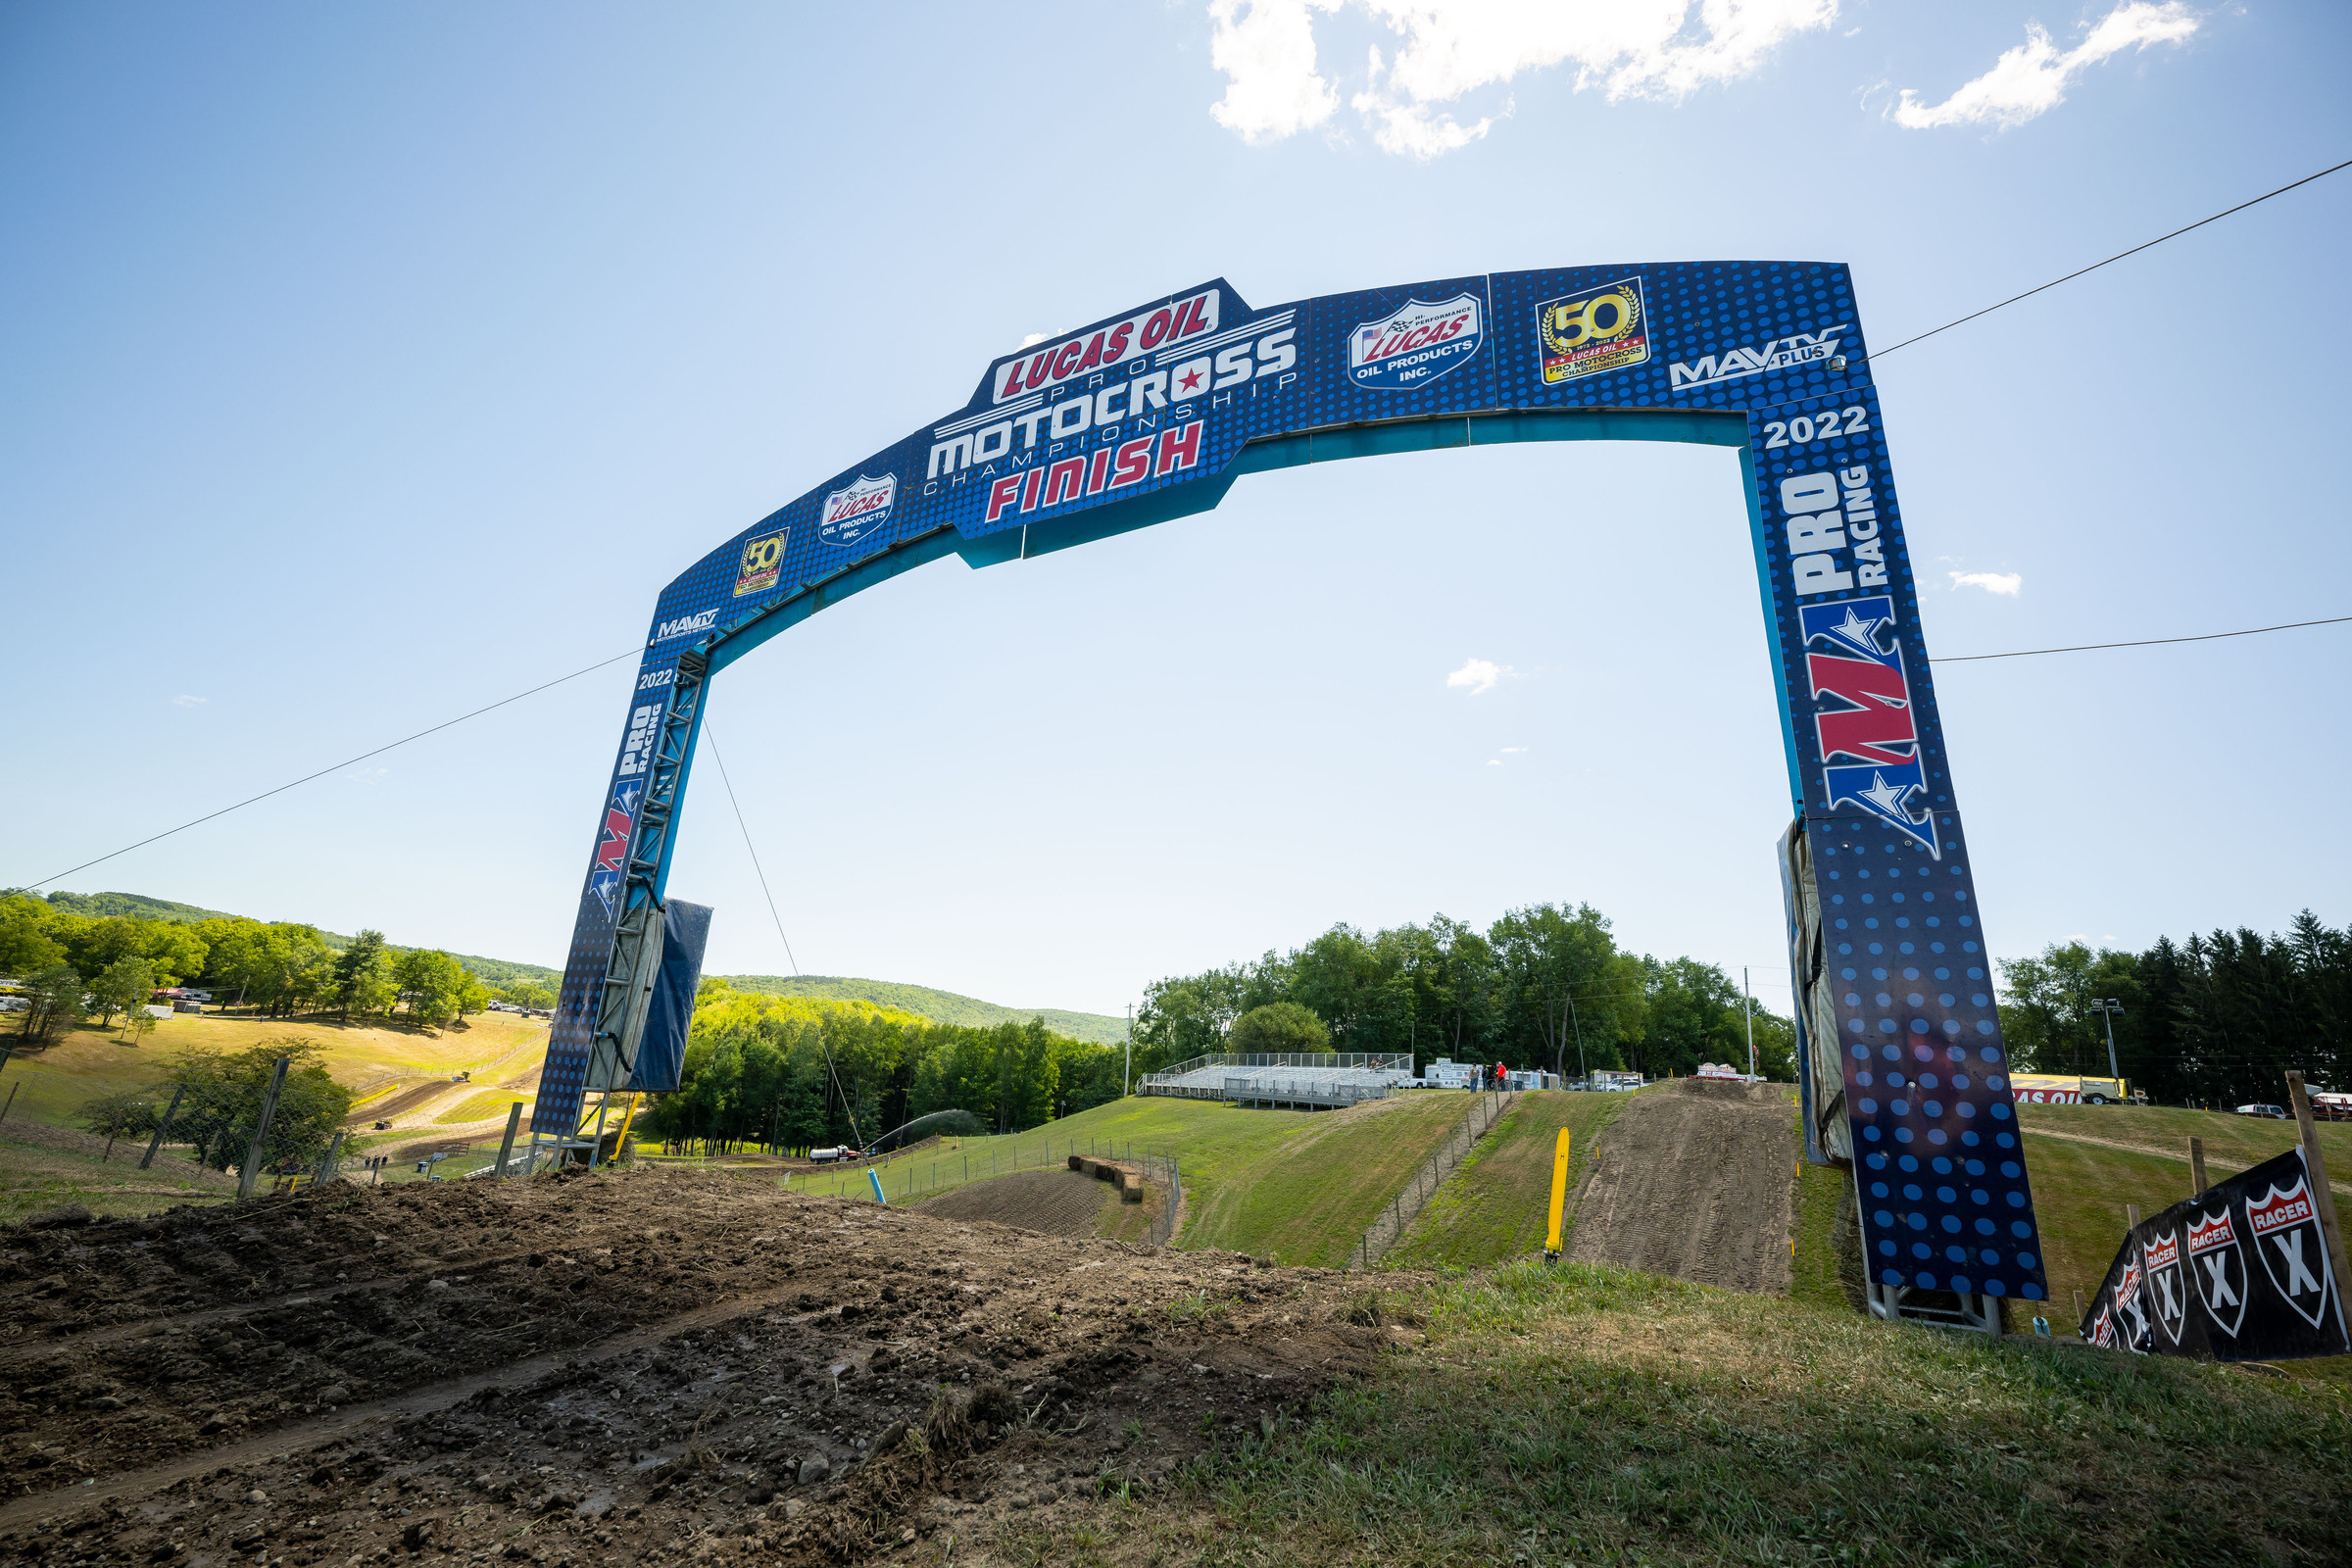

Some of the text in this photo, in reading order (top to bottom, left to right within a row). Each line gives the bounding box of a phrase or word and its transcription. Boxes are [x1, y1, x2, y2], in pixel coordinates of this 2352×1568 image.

[1415, 306, 1472, 325] PERFORMANCE
[1554, 294, 1632, 347] 50
[1002, 295, 1210, 398] LUCAS OIL
[1356, 339, 1473, 379] OIL PRODUCTS
[1362, 314, 1470, 363] LUCAS
[1549, 346, 1642, 374] PRO MOTOCROSS
[1571, 344, 1617, 361] LUCAS OIL
[1669, 323, 1848, 387] MAVTV
[1779, 345, 1825, 366] PLUS
[1051, 359, 1147, 402] PRO
[1562, 357, 1630, 377] CHAMPIONSHIP
[927, 327, 1297, 480] MOTOCROSS
[923, 371, 1297, 496] CHAMPIONSHIP
[1764, 406, 1870, 449] 2022
[985, 419, 1204, 524] FINISH
[822, 510, 887, 536] OIL PRODUCTS
[827, 490, 889, 522] LUCAS
[1839, 465, 1888, 588] RACING
[746, 537, 780, 572] 50
[1781, 471, 1854, 596] PRO
[638, 668, 673, 690] 2022
[619, 705, 653, 776] PRO
[637, 703, 662, 773] RACING
[2254, 1200, 2309, 1231] RACER
[2147, 1246, 2177, 1271] RACER
[2191, 1227, 2231, 1250] RACER
[2202, 1250, 2240, 1309] X
[2272, 1228, 2321, 1298] X
[2156, 1268, 2181, 1321] X
